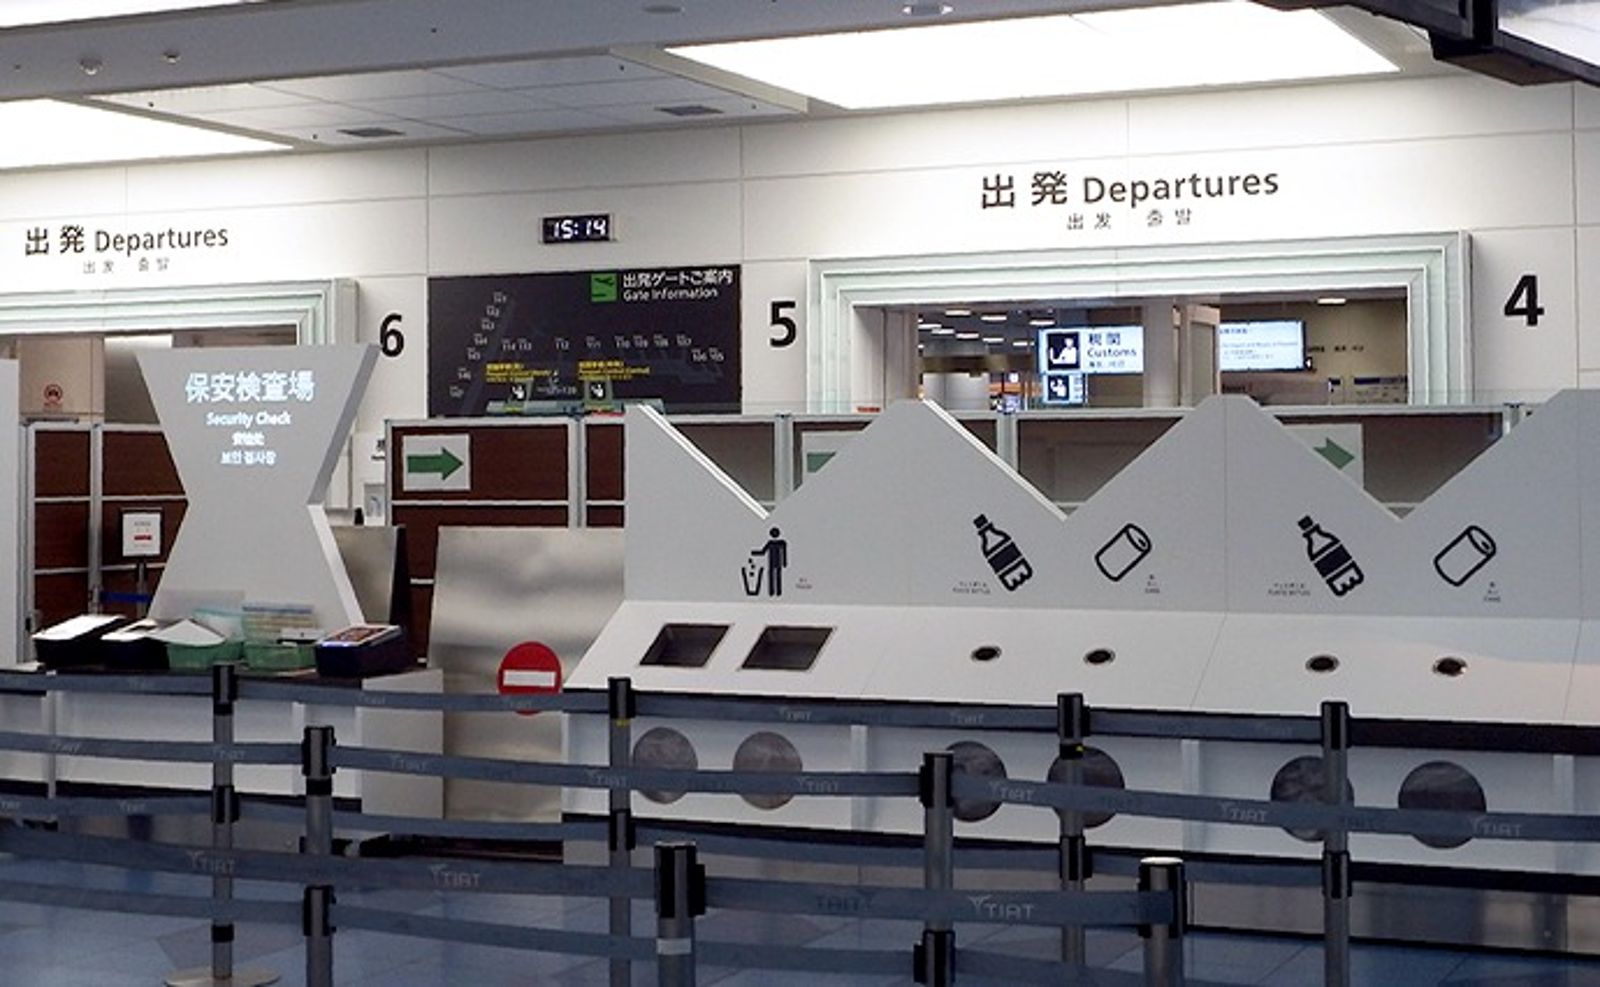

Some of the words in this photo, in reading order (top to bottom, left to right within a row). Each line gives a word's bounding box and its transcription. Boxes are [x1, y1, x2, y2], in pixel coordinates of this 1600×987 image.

[981, 171, 1068, 209] 出発
[1082, 173, 1280, 209] Departures
[25, 224, 85, 257] 出発
[94, 228, 229, 257] Departures
[554, 219, 606, 239] 15:14
[623, 269, 734, 289] 出発ゲートご案内
[623, 289, 650, 302] Gate
[651, 287, 719, 300] Information
[1504, 275, 1545, 326] 4
[380, 313, 404, 357] 6
[770, 301, 797, 347] 5
[1087, 347, 1137, 358] Customs
[184, 371, 315, 404] 保安検査場
[205, 411, 254, 429] Security
[255, 410, 292, 426] Check
[983, 903, 1036, 920] TIAT
